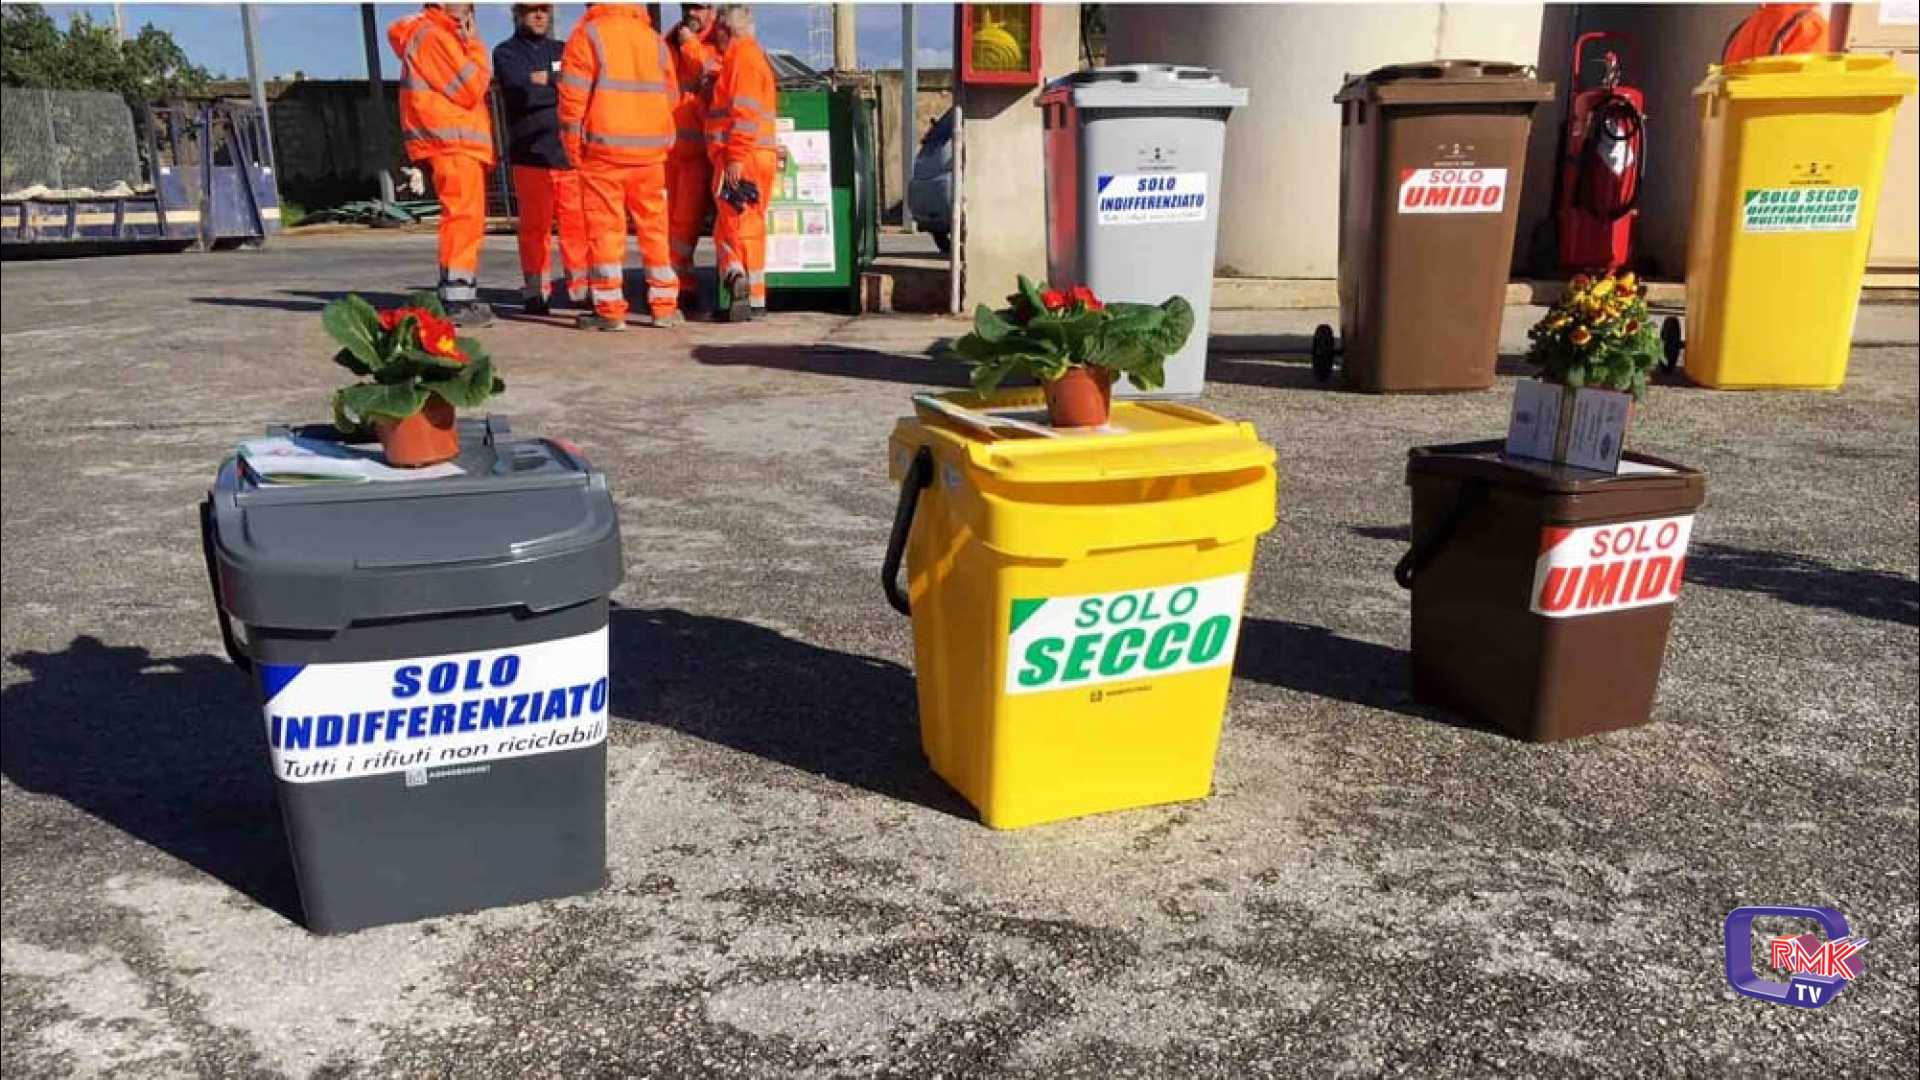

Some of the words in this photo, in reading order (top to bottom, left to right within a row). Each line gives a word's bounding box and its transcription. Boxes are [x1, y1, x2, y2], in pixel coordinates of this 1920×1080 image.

[1138, 176, 1175, 191] SOLO
[1429, 169, 1484, 184] SOLO
[1101, 194, 1204, 211] INDIFFERENZIATO
[1405, 185, 1501, 208] UMIDO
[1759, 191, 1801, 203] SOLO
[1806, 189, 1859, 202] SECCO
[1590, 521, 1679, 558] SOLO
[1074, 586, 1199, 628] SOLO
[1017, 613, 1232, 687] SECCO
[391, 653, 521, 699] SOLO
[270, 676, 607, 750] INDIFFERENZIATO
[284, 755, 338, 777] Tutti
[345, 755, 355, 773] i
[363, 746, 432, 770] rifiuti
[439, 742, 489, 761] non
[497, 719, 603, 753] riciclabili
